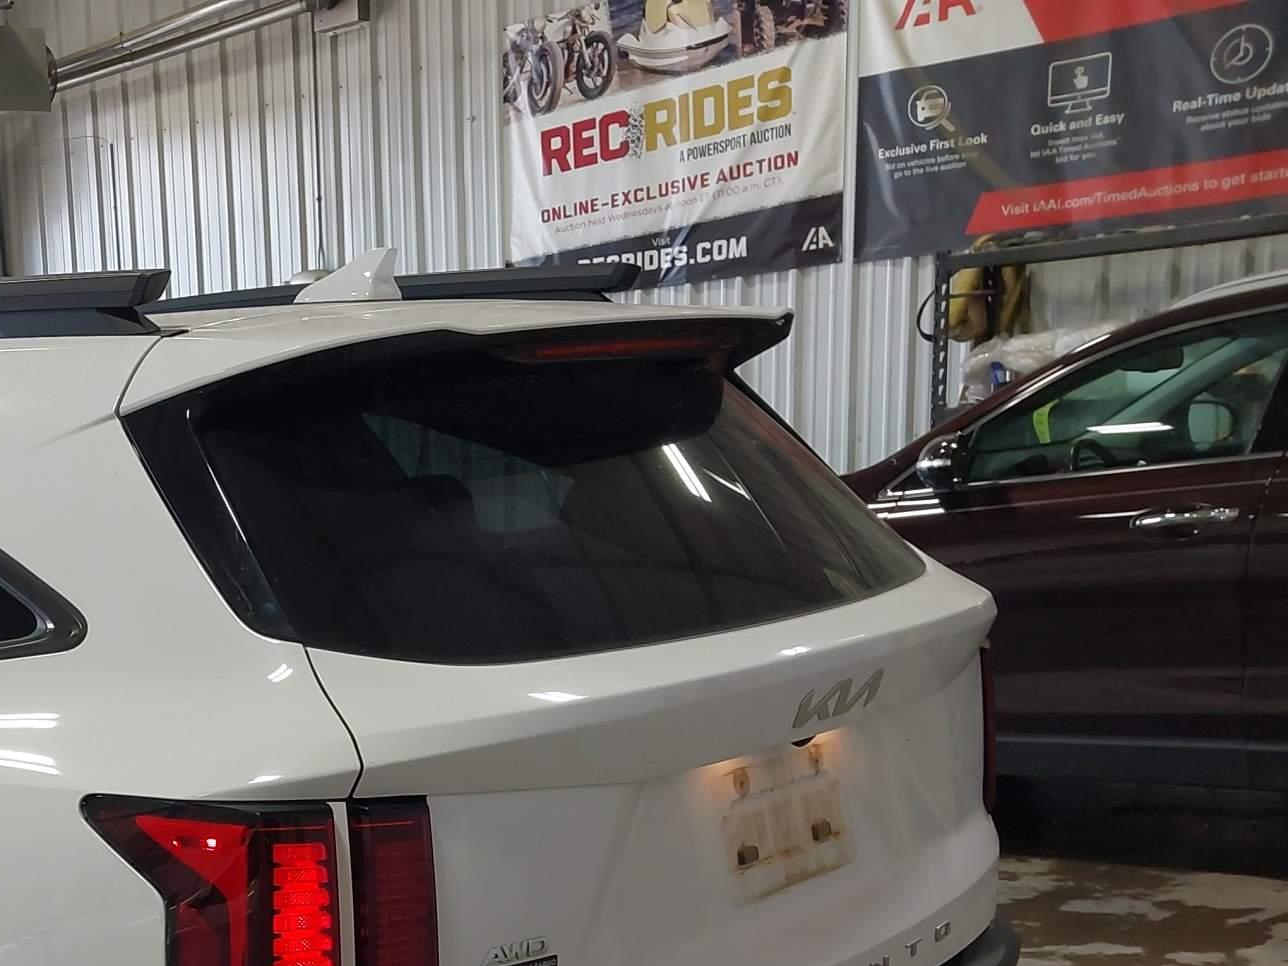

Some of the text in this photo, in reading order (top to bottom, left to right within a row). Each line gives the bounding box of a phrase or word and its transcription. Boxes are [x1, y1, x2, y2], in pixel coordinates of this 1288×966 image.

[1173, 91, 1242, 113] Real-Time
[541, 66, 792, 176] REC RIDES
[1030, 113, 1126, 136] Quick and Easy
[679, 122, 792, 163] A POWERSPORT AUCTION
[878, 132, 989, 159] Exclusive First Look
[541, 150, 800, 223] ONLINE-EXCLUSIVE AUCTION
[1001, 203, 1030, 217] Visit
[1203, 178, 1218, 190] to
[1221, 173, 1246, 190] get
[555, 221, 586, 235] Auction
[652, 237, 672, 248] Visit
